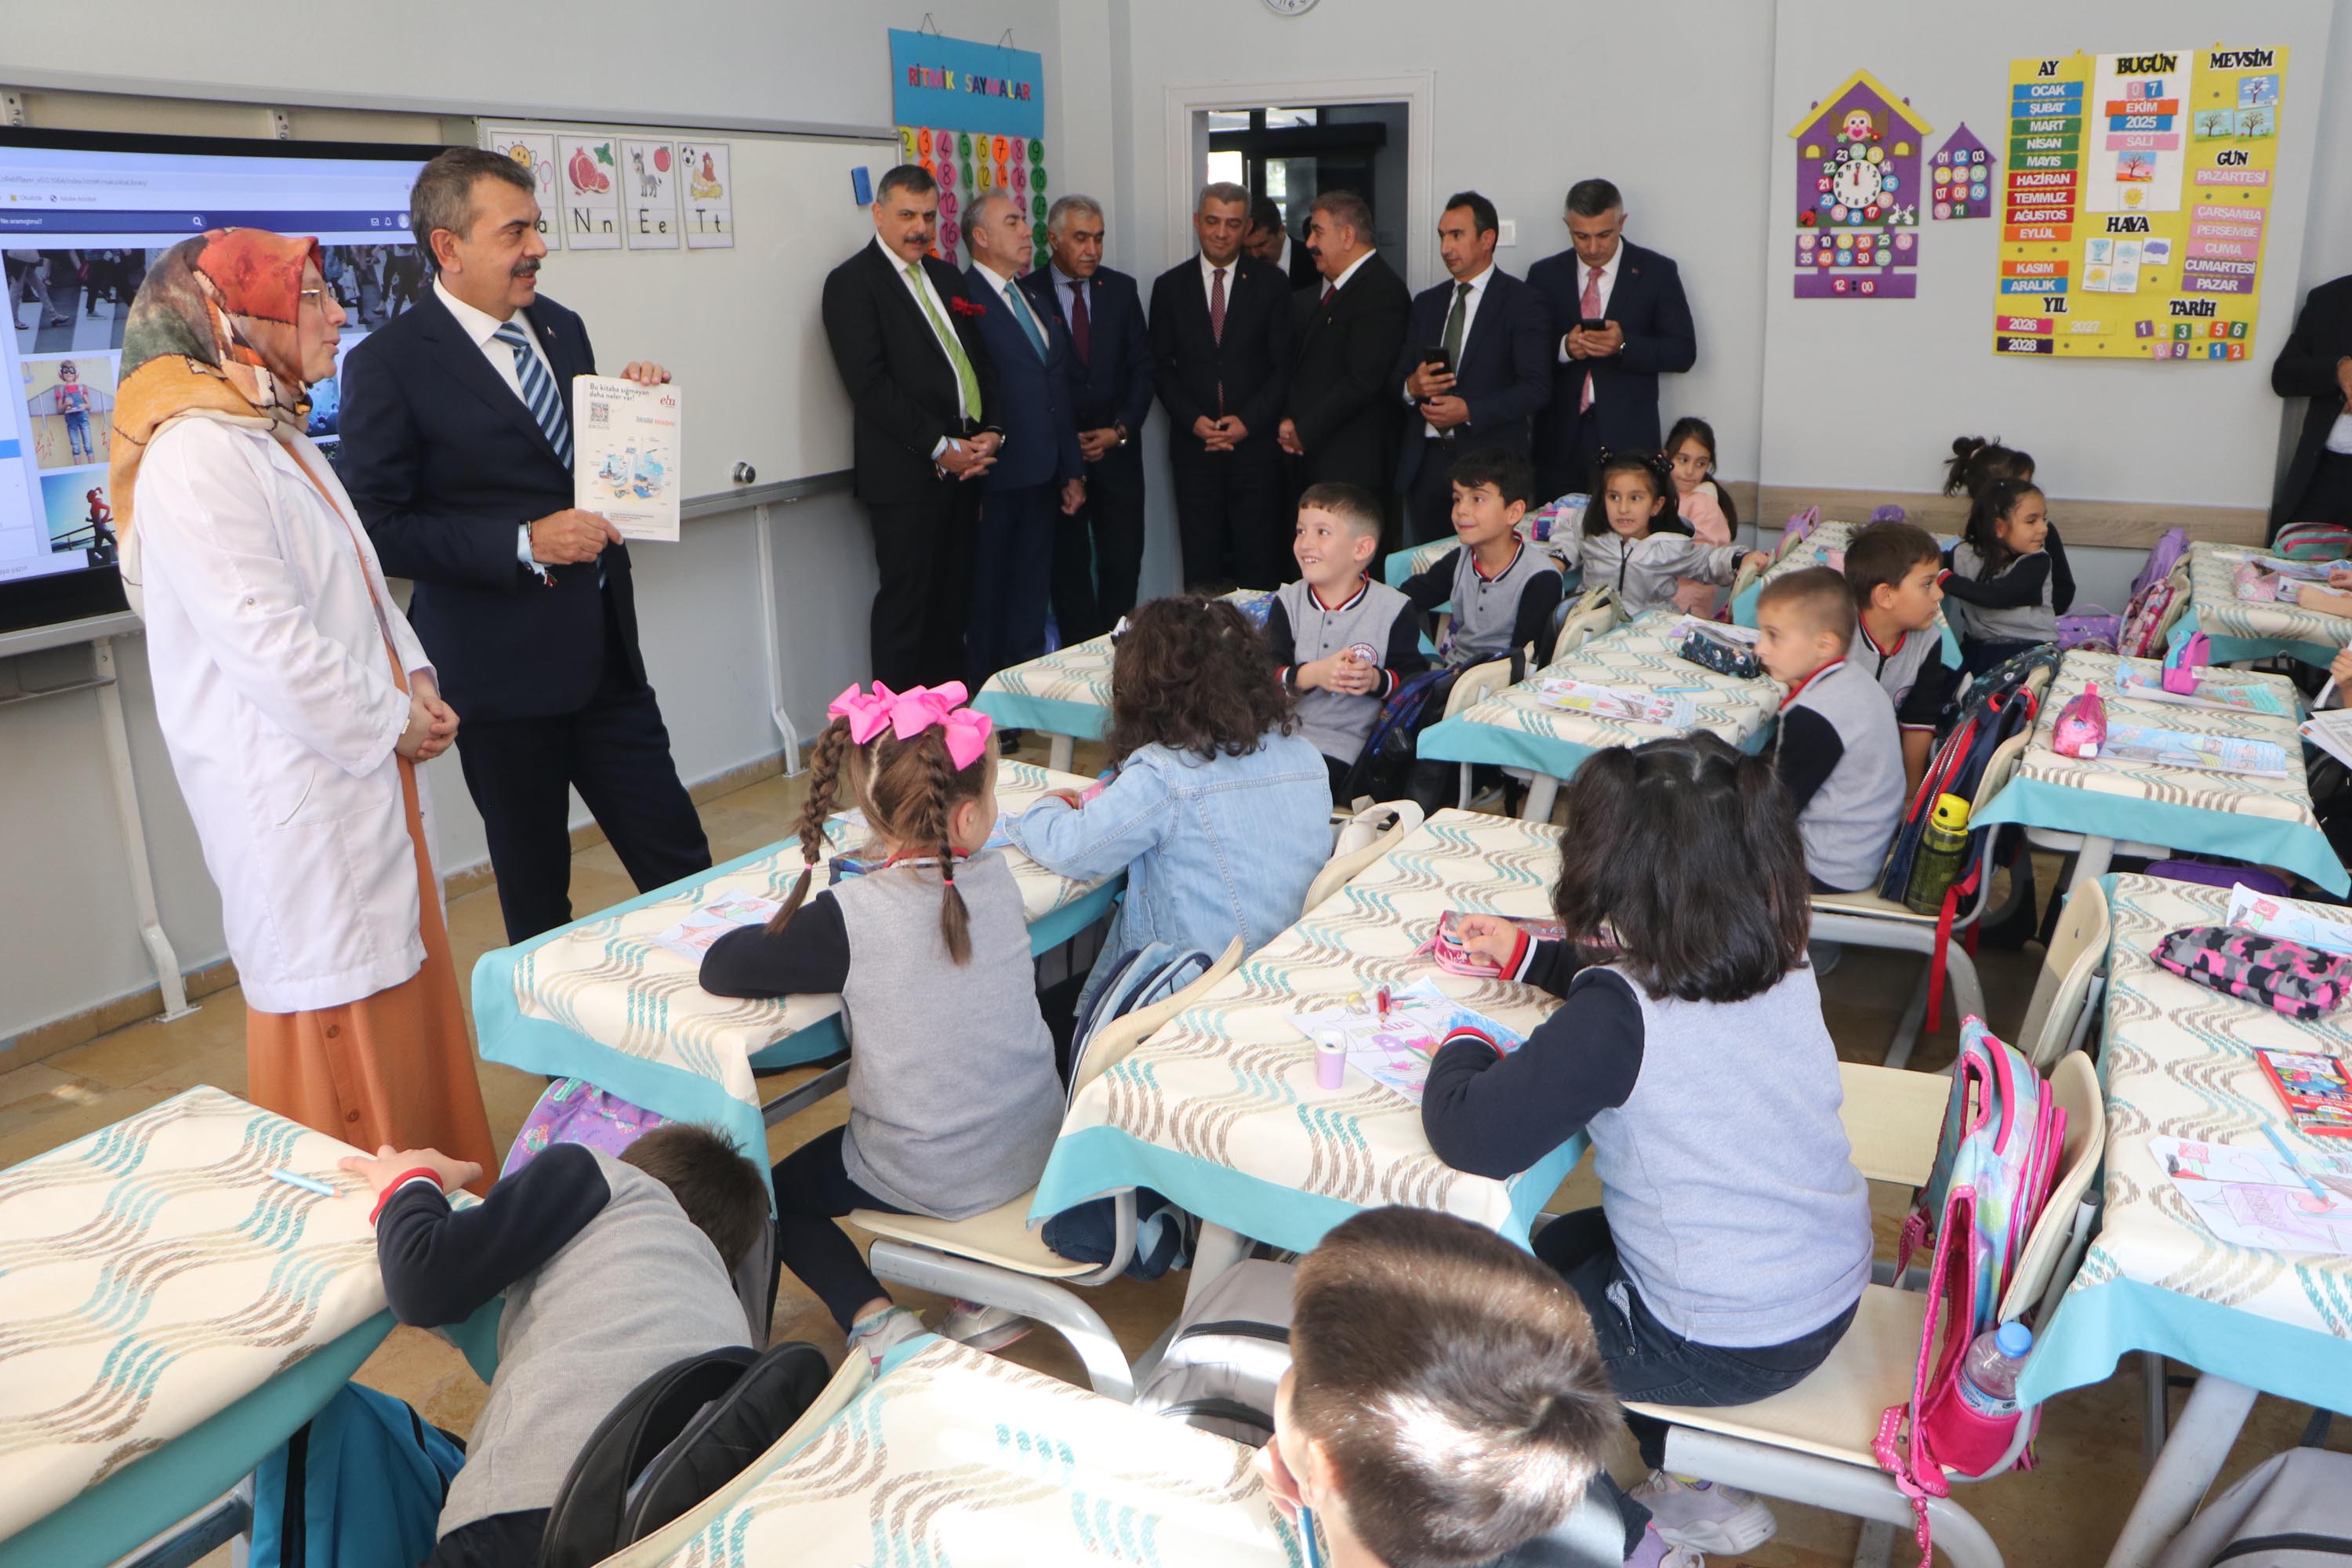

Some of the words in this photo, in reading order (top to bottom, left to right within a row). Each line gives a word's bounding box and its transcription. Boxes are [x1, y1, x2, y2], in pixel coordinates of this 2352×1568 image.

[2117, 53, 2177, 74] BUGÜN
[2209, 47, 2274, 68] MEVSİM
[2038, 61, 2059, 76] AY
[908, 63, 955, 89] RİTMİK
[966, 74, 1030, 100] SAYMALAR
[2031, 85, 2065, 96] OCAK
[2029, 102, 2066, 116] ŞUBAT
[2126, 100, 2158, 113] EKİM
[2030, 120, 2066, 132] MART
[2125, 115, 2157, 129] 2025
[922, 130, 930, 153] 3
[942, 133, 949, 155] 4
[961, 135, 970, 156] 5
[980, 136, 987, 157] 6
[996, 140, 1005, 158] 7
[1016, 140, 1022, 160] 8
[1032, 142, 1040, 161] 9
[2027, 136, 2062, 150] NİSAN
[2126, 136, 2154, 147] SALI
[1835, 149, 1849, 162] 23
[1938, 151, 1948, 163] 01
[1955, 151, 1966, 162] 02
[1973, 151, 1985, 162] 03
[2027, 155, 2062, 167] MAYIS
[2217, 150, 2249, 166] GÜN
[1824, 162, 1835, 174] 22
[1881, 162, 1891, 172] 14
[944, 164, 951, 185] 8
[1013, 167, 1025, 187] 16
[2016, 172, 2070, 187] HAZİRAN
[2198, 169, 2266, 183] PAZARTESİ
[1819, 178, 1830, 190] 21
[1886, 177, 1896, 188] 15
[1821, 193, 1833, 205] 20
[1936, 187, 1947, 199] 07
[1955, 187, 1966, 199] 08
[1973, 186, 1984, 198] 09
[2015, 191, 2067, 204] TEMMUZ
[941, 193, 956, 213] 12
[1955, 204, 1964, 215] 11
[575, 207, 590, 233] N
[604, 220, 612, 233] n
[1852, 212, 1861, 223] 18
[1867, 206, 1877, 218] 17
[2013, 209, 2067, 221] AĞUSTOS
[2198, 206, 2261, 220] ÇARŞAMBA
[640, 209, 650, 234] E
[659, 220, 666, 234] e
[696, 209, 706, 232] T
[715, 213, 721, 232] t
[2106, 216, 2150, 232] HAVA
[942, 222, 956, 243] 16
[2020, 226, 2056, 238] EYLÜL
[2197, 225, 2258, 238] PERŞEMBE
[1820, 236, 1831, 246] 10
[1860, 237, 1871, 248] 20
[1878, 234, 1889, 245] 25
[2205, 242, 2242, 255] CUMA
[1801, 252, 1813, 263] 35
[1819, 252, 1831, 263] 40
[1838, 251, 1850, 263] 45
[1858, 252, 1869, 263] 50
[2016, 263, 2054, 274] KASIM
[2184, 259, 2256, 274] CUMARTESİ
[2010, 280, 2056, 292] ARALIK
[2197, 278, 2238, 292] PAZAR
[2043, 297, 2067, 312] YIL
[2170, 298, 2217, 317] TARİH
[2009, 317, 2038, 331] 2026
[2070, 321, 2101, 332] 2027
[2140, 321, 2147, 336] 1
[2179, 325, 2187, 339] 3
[2215, 323, 2223, 336] 5
[2234, 323, 2243, 336] 6
[2009, 339, 2038, 351] 2028
[2157, 344, 2165, 356] 8
[2176, 343, 2184, 357] 9
[2215, 343, 2220, 357] 1
[2233, 345, 2241, 358] 2
[601, 383, 619, 392] kitaba
